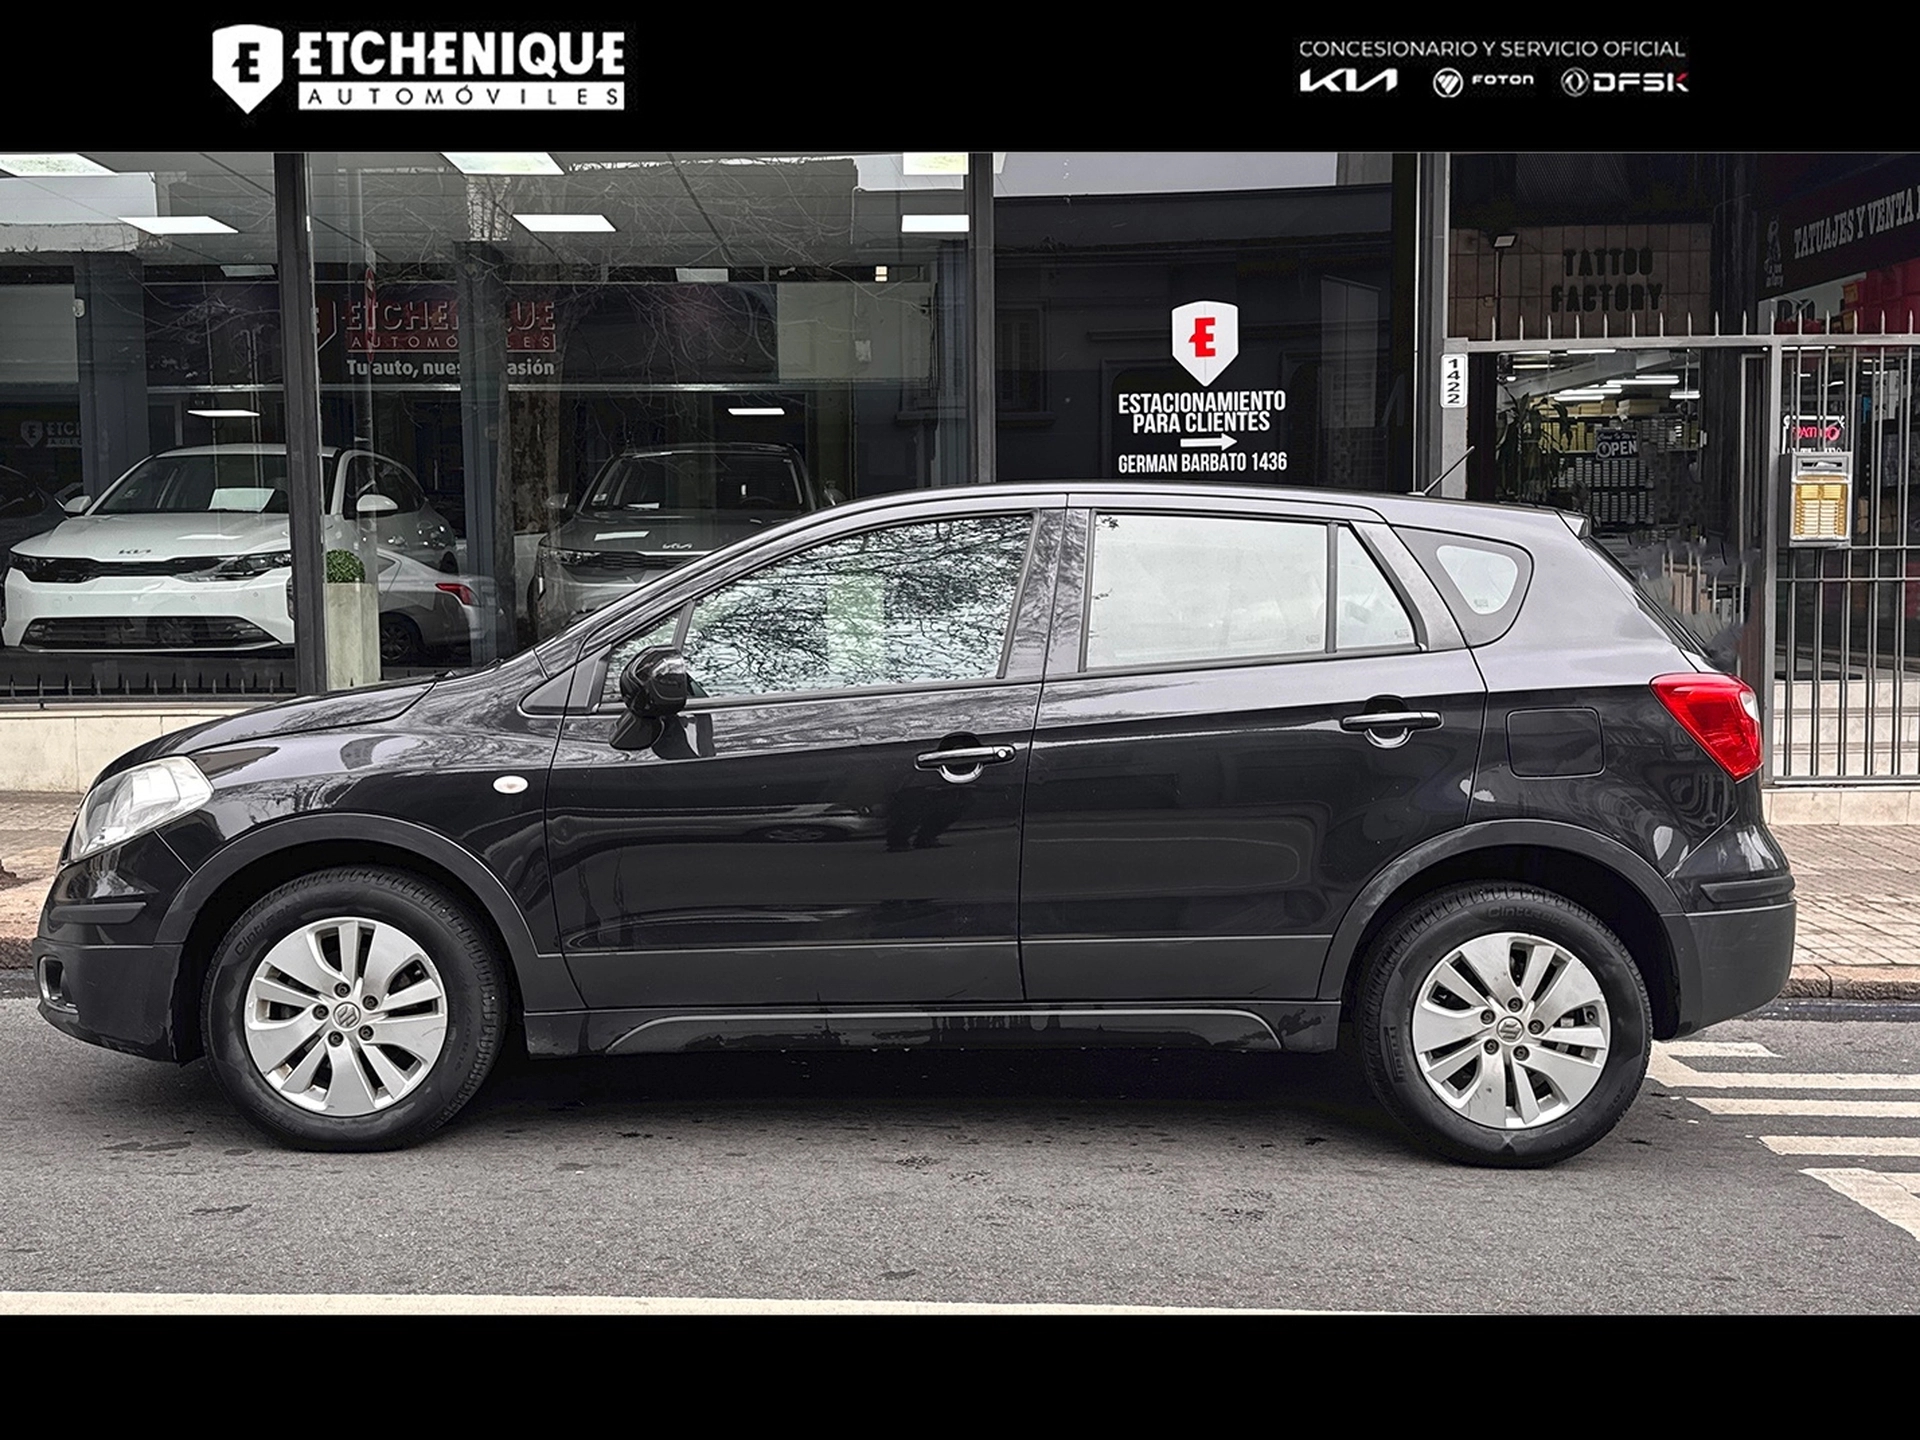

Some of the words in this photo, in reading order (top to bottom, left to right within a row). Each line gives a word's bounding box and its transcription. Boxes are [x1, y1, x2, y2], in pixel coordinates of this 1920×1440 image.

[1793, 209, 1855, 260] TATUAJES
[1856, 204, 1867, 240] Y
[1867, 187, 1914, 236] VENTA
[1563, 248, 1653, 276] TATTOO
[1551, 283, 1664, 312] FACTORY
[347, 359, 369, 376] Tu
[372, 360, 420, 379] auto,
[1447, 358, 1461, 404] 1422
[1118, 390, 1287, 415] ESTACIONAMIENTO
[1133, 413, 1181, 434] PARA
[1185, 411, 1271, 433] CLIENTES
[1596, 440, 1638, 458] OPEN
[1118, 454, 1178, 474] GERMAN
[1181, 452, 1247, 472] BARBATO
[1251, 451, 1288, 471] 1436
